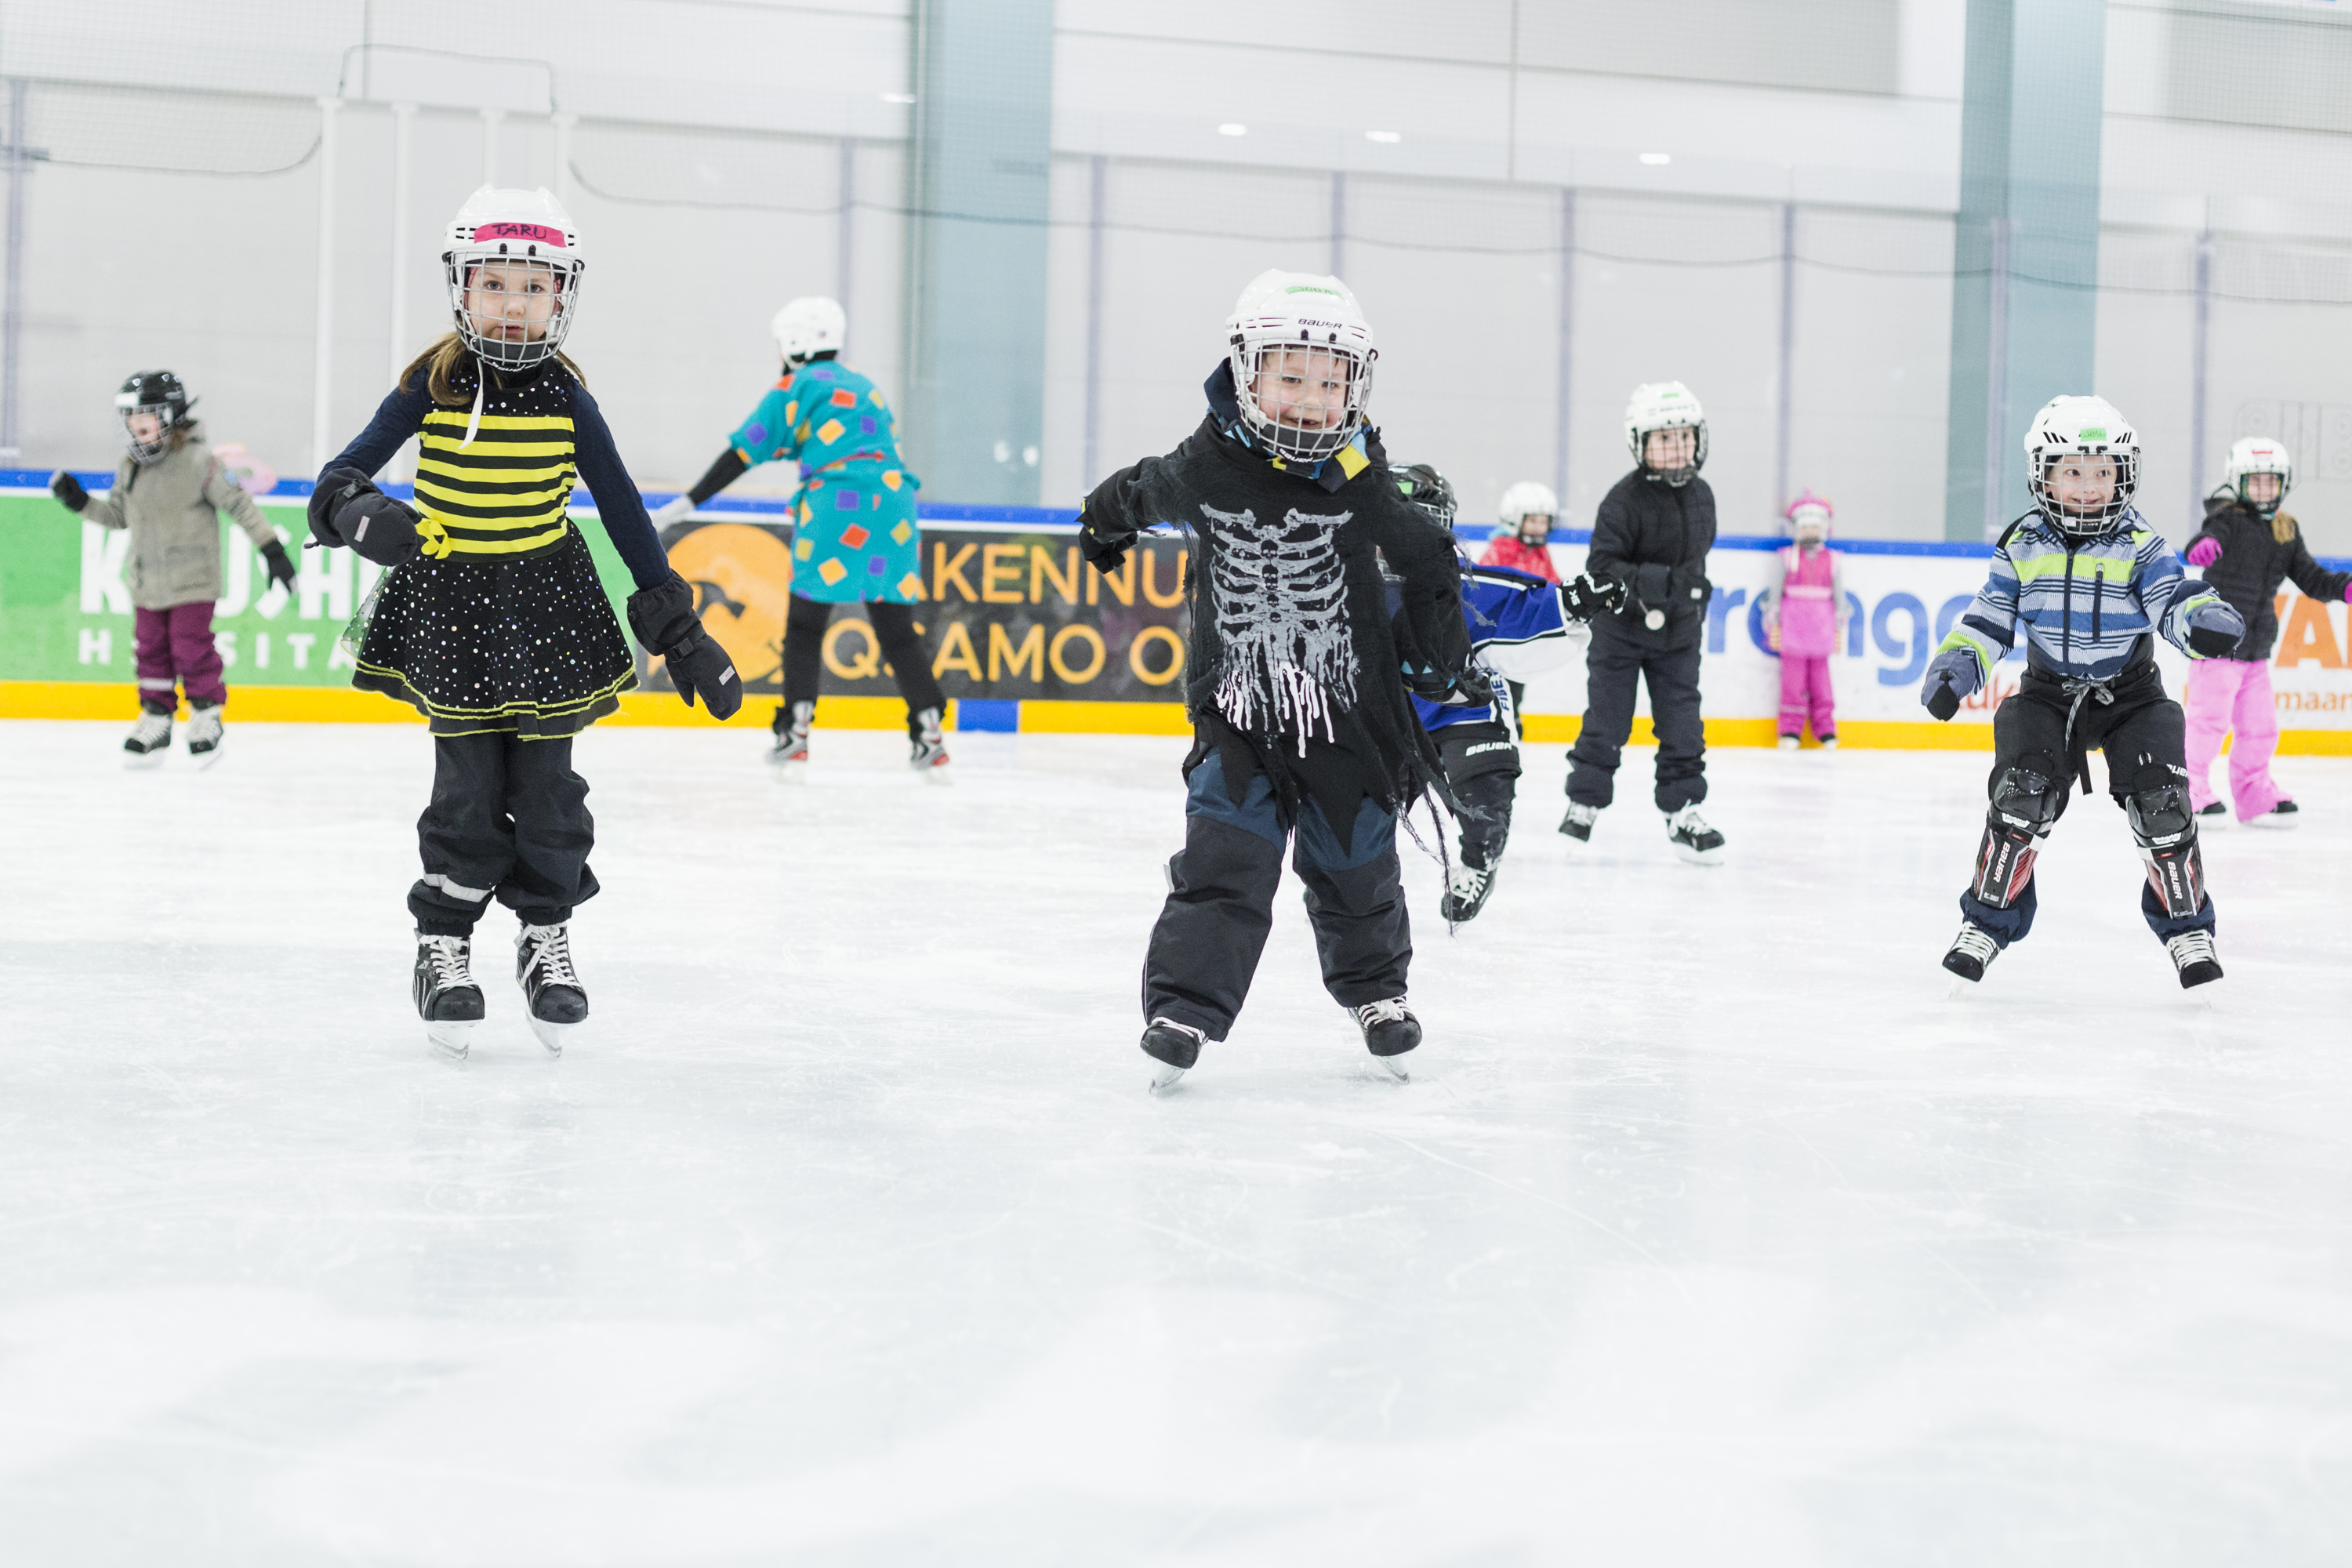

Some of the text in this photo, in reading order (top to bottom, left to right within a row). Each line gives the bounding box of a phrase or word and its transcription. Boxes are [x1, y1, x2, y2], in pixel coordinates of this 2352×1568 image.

[492, 224, 547, 239] TARU
[1465, 742, 1512, 757] BAUER
[1993, 841, 2011, 884] BAUER
[2167, 861, 2183, 900] BAUER
